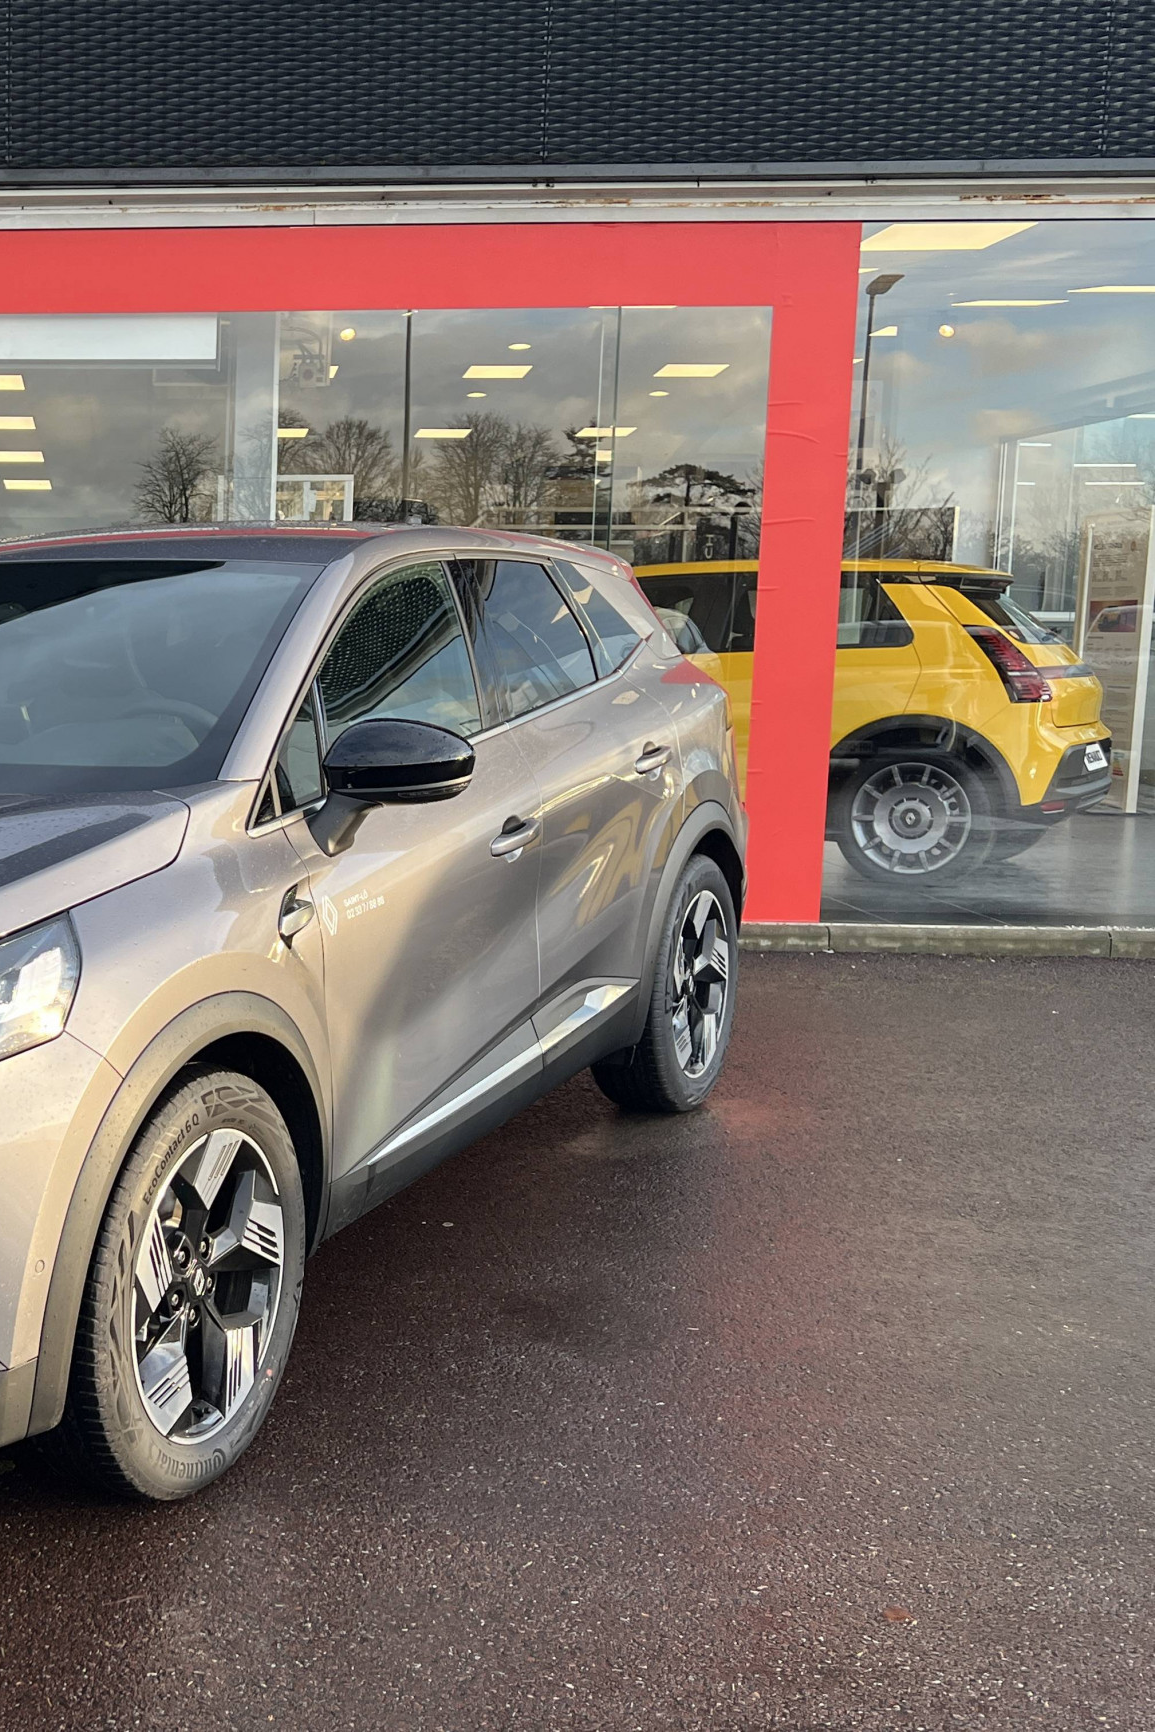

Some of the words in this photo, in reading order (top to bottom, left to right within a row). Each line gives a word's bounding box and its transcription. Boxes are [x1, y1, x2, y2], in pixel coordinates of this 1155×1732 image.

[142, 1129, 186, 1206] EcoContact
[185, 1119, 192, 1134] 6
[191, 1113, 200, 1126] Q
[158, 1447, 226, 1479] Continental
